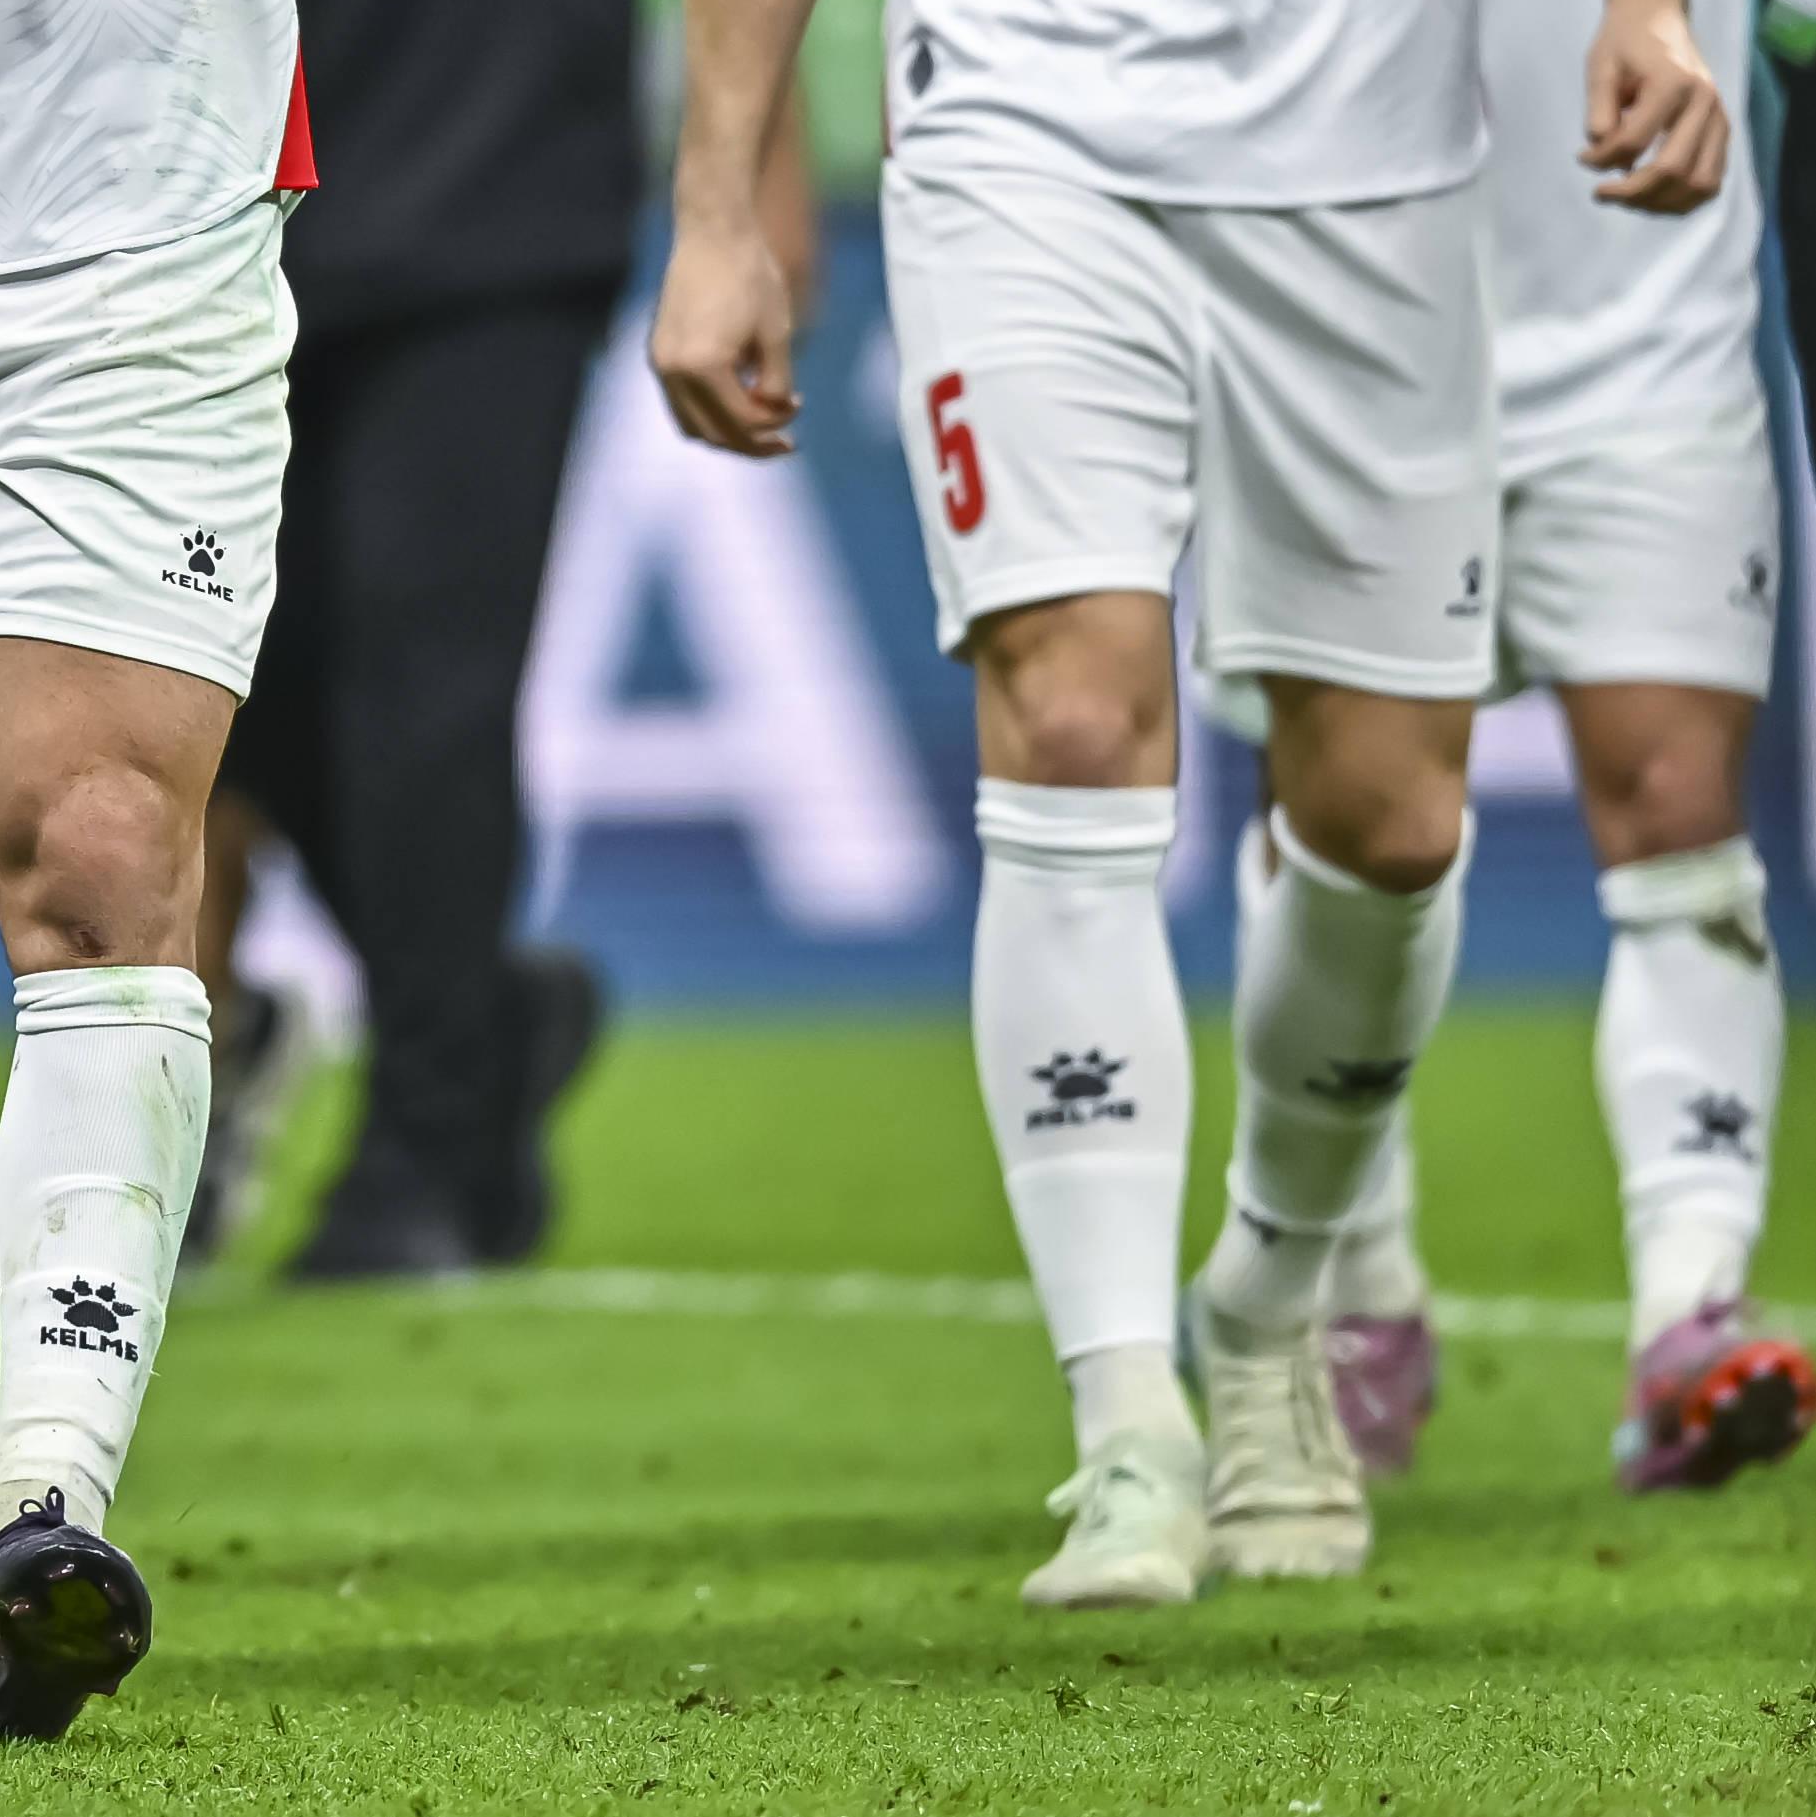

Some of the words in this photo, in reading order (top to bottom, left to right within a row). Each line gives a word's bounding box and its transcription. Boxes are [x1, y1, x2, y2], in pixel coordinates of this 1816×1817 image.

[928, 371, 987, 535] 5
[161, 568, 235, 603] KELME
[39, 1325, 140, 1364] KELME
